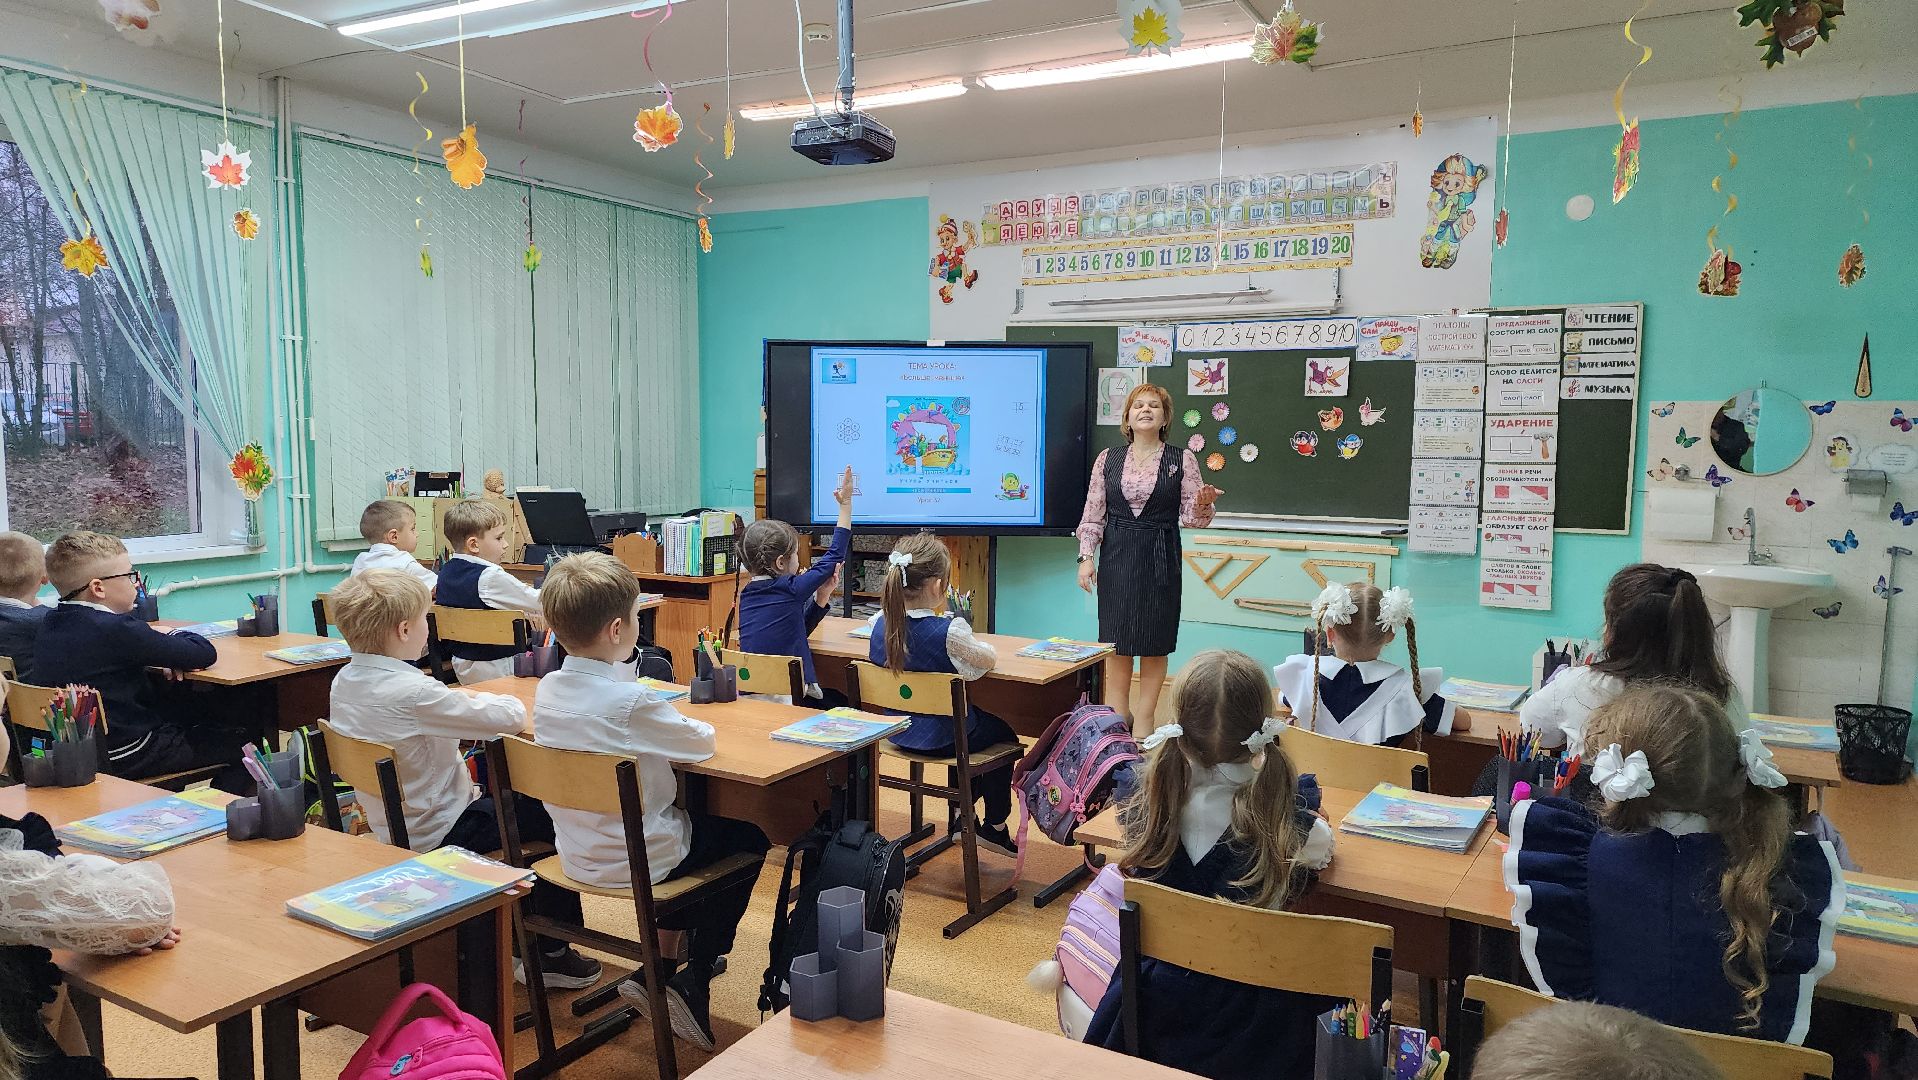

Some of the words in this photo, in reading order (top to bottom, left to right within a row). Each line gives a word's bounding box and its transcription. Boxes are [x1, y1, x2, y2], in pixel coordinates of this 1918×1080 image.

[1035, 258, 1041, 273] 1
[1046, 258, 1054, 273] 2
[1057, 256, 1066, 272] 3
[1069, 256, 1078, 271] 4
[1080, 255, 1089, 270] 5
[1091, 255, 1100, 270] 6
[1104, 254, 1113, 270] 7
[1114, 252, 1123, 268] 8
[1126, 251, 1136, 267] 9
[1139, 250, 1155, 267] 10
[1160, 249, 1172, 265] 11
[1176, 248, 1191, 264] 12
[1195, 246, 1210, 262] 13
[1234, 243, 1249, 260] 15
[1254, 241, 1269, 258] 16
[1273, 240, 1289, 257] 17
[1291, 238, 1309, 256] 18
[1311, 237, 1328, 255] 19
[1331, 235, 1350, 254] 20
[1584, 313, 1635, 323] ЧТЕНИЕ
[1495, 319, 1551, 328] ПРЕДЛОЖЕНИЕ
[1182, 329, 1193, 346] 0
[1201, 328, 1209, 346] 1
[1213, 327, 1225, 345] 2
[1230, 327, 1240, 345] 3
[1245, 326, 1256, 345] 4
[1260, 325, 1272, 344] 5
[1275, 325, 1288, 344] 6
[1293, 325, 1305, 343] 7
[1309, 324, 1321, 343] 8
[1325, 323, 1337, 342] 9
[1338, 323, 1355, 342] 10
[1588, 336, 1635, 346] ПИСЬМО
[1579, 360, 1635, 368] МАТЕМАТИКА
[1520, 368, 1558, 376] ДЕЛИТСЯ
[1584, 385, 1631, 394] МУЗЫКА
[1490, 419, 1554, 428] УДАРЕНИЕ
